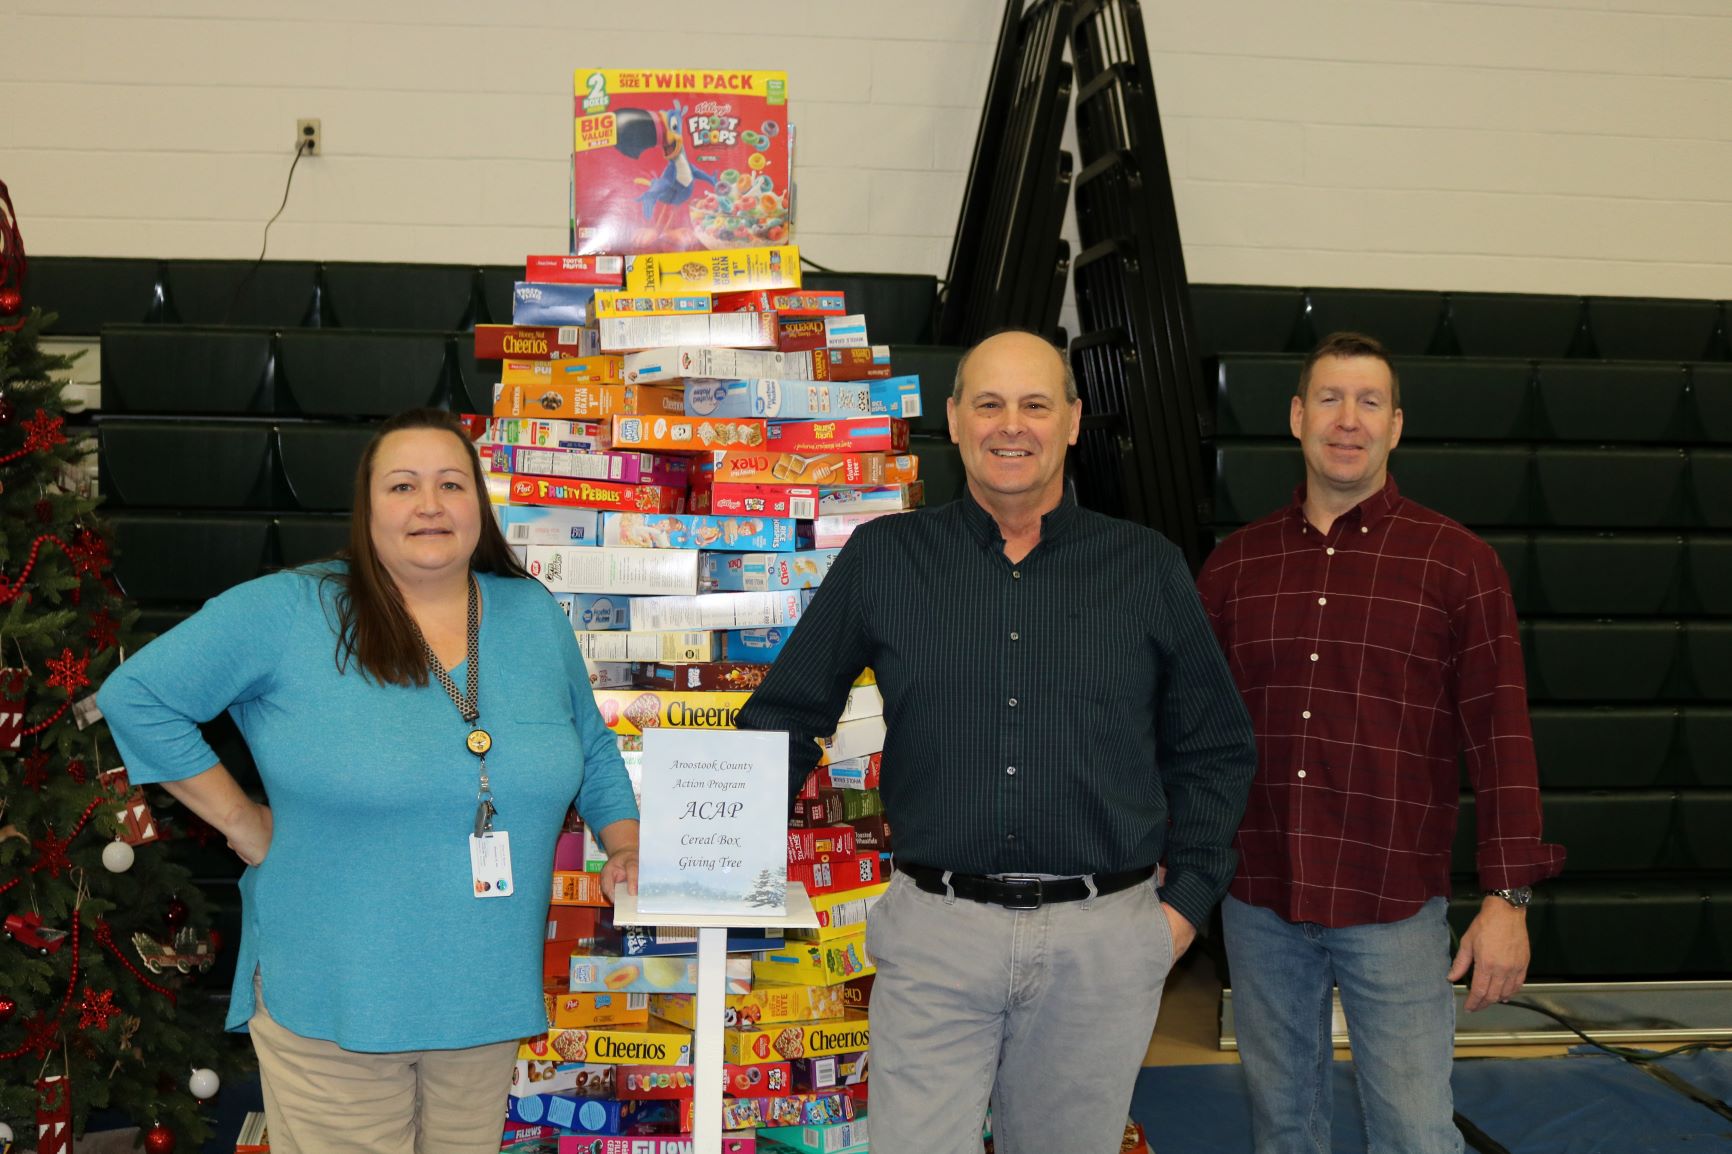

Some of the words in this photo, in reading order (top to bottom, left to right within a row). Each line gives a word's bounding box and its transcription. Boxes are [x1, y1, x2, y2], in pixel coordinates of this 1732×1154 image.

[587, 74, 605, 99] 2
[619, 79, 640, 88] SIZE
[642, 74, 696, 88] TWIN
[703, 75, 753, 89] PACK
[583, 96, 609, 108] BOXES
[695, 102, 732, 117] Kellogg's
[581, 115, 614, 133] BIG
[689, 116, 740, 132] FROOT
[582, 130, 613, 142] VALUE!
[692, 130, 738, 147] LOOPS
[712, 256, 720, 286] WHOLE
[720, 256, 729, 285] GRAIN
[786, 321, 823, 334] Cheerios
[503, 335, 548, 354] Cheerios
[731, 455, 768, 471] Chex
[847, 459, 855, 481] Gluten
[515, 483, 532, 493] Post
[537, 480, 580, 500] FRUITY
[580, 483, 621, 502] PEBBLES
[772, 519, 780, 548] KRISPIES
[545, 563, 554, 582] Corn
[780, 561, 789, 585] Chex
[667, 701, 740, 727] Cheerio
[669, 760, 718, 771] Aroostook
[719, 760, 753, 773] County
[672, 779, 704, 789] Action
[708, 779, 746, 791] Program
[679, 801, 744, 820] ACAP
[680, 833, 717, 846] Cereal
[717, 835, 742, 847] Box
[678, 857, 716, 871] Giving
[718, 856, 742, 868] Tree
[780, 994, 788, 1016] BITE
[594, 1036, 666, 1059] Cheerios
[810, 1030, 869, 1051] Cheerios
